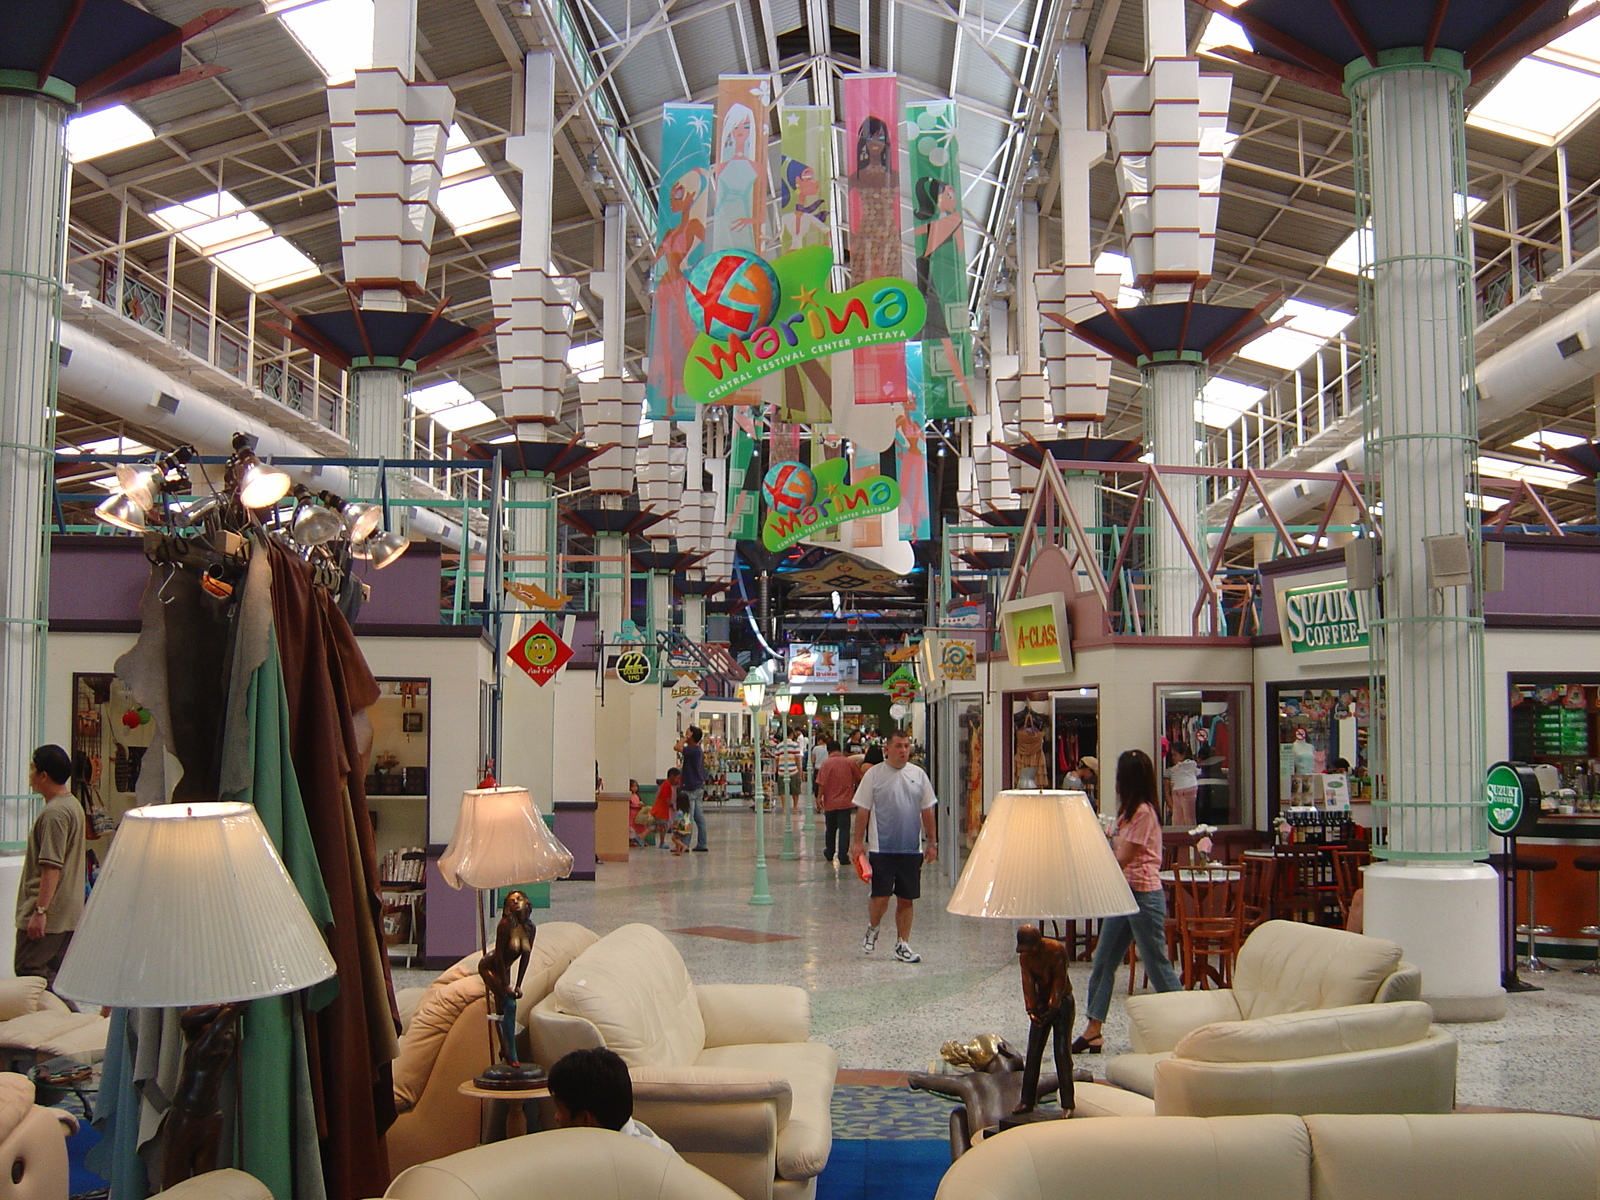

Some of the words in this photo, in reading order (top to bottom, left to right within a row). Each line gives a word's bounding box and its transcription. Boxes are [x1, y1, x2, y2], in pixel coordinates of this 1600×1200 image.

[708, 372, 753, 398] CENTRAL
[757, 351, 805, 374] FESTIVAL
[811, 339, 852, 354] CENTER
[857, 330, 907, 344] PATTAYA
[777, 532, 803, 549] CENTRAL
[804, 519, 833, 534] FESTIVAL
[835, 511, 860, 522] CENTER
[862, 506, 891, 515] PATTAYA
[1287, 588, 1368, 642] SUZUKI
[1306, 622, 1359, 646] COFFEE
[624, 654, 642, 668] 22
[1487, 784, 1519, 807] SUZUKI
[1493, 796, 1514, 804] COFFEE
